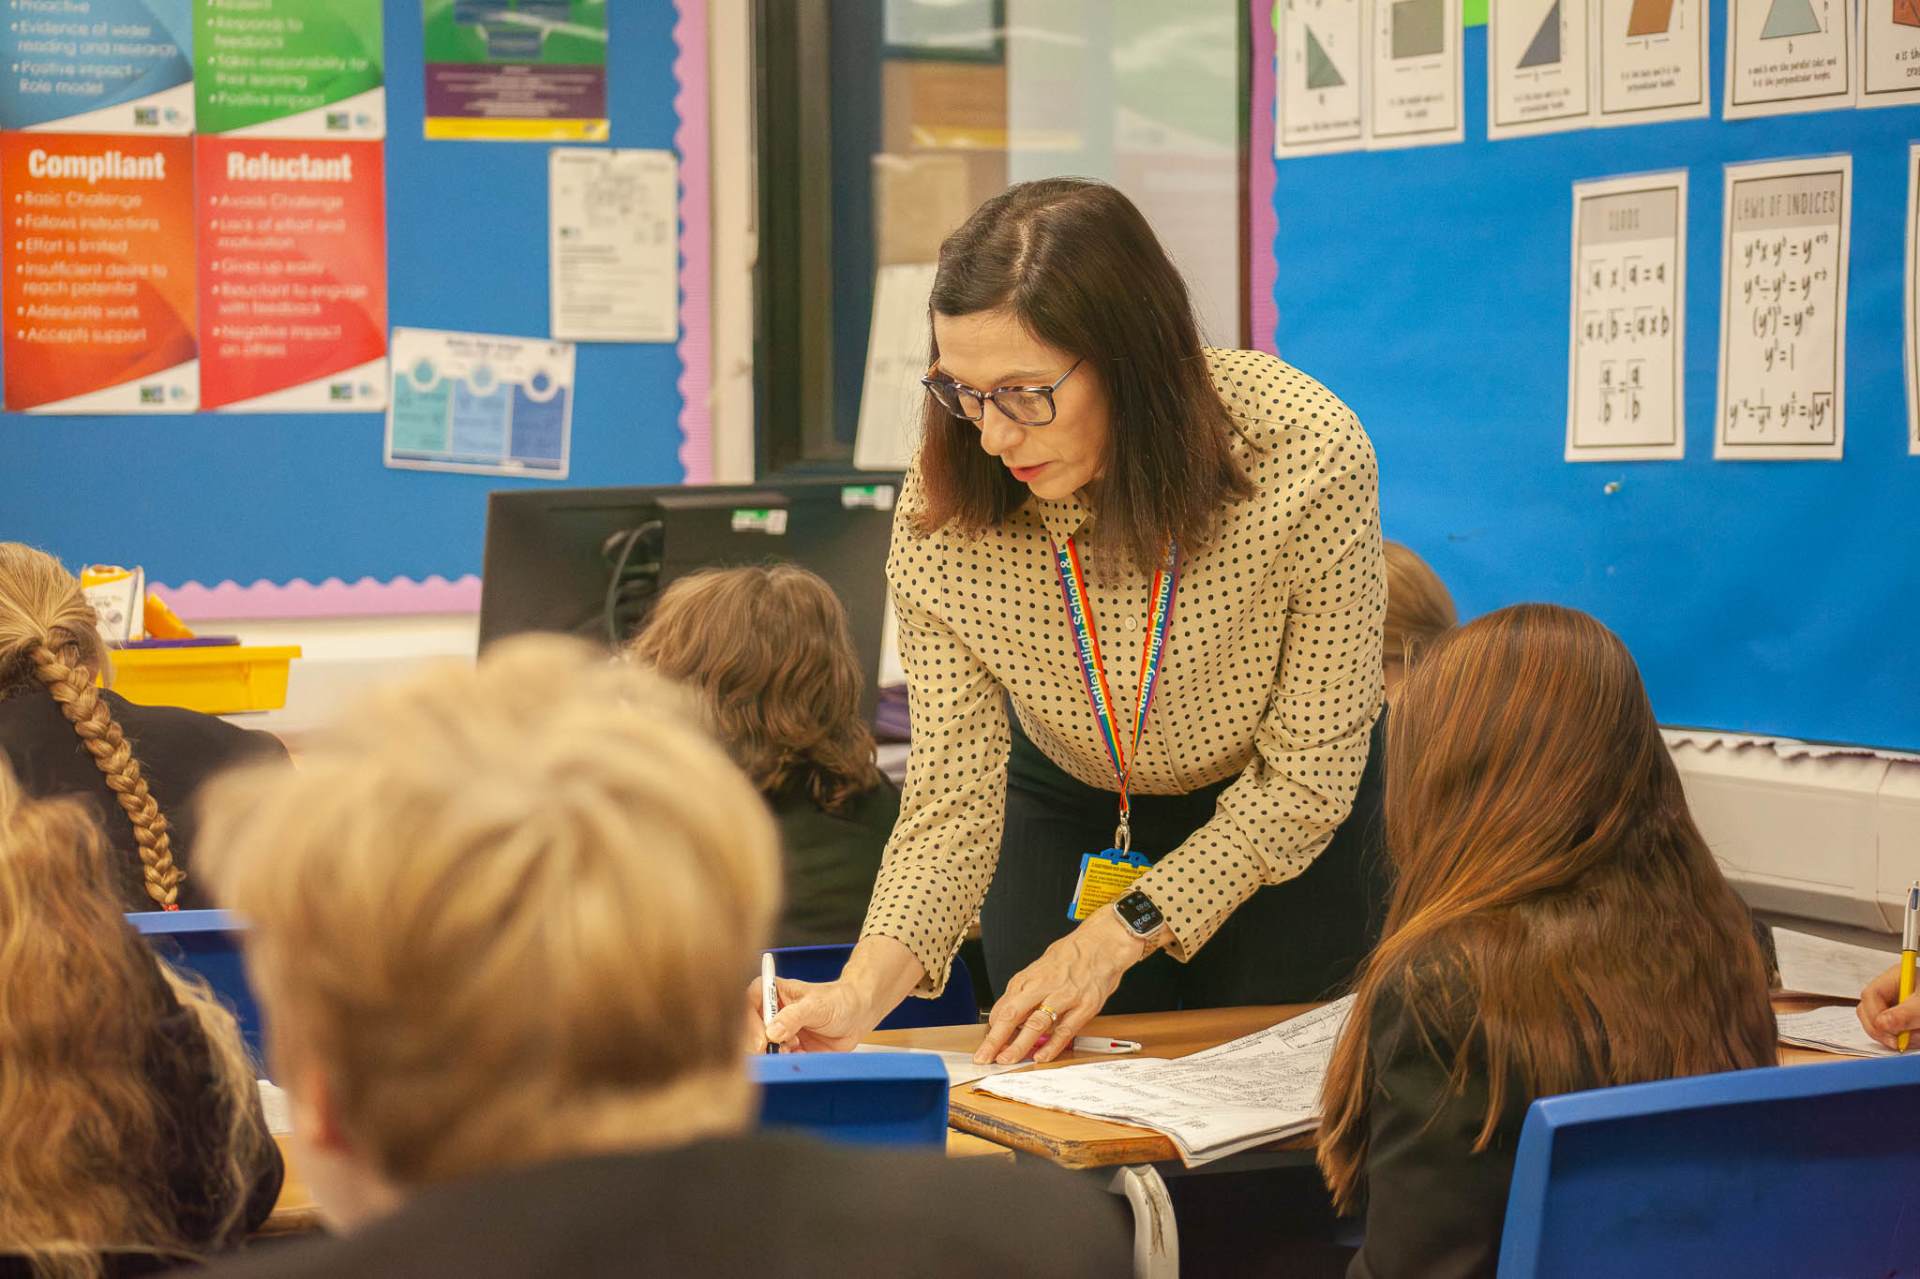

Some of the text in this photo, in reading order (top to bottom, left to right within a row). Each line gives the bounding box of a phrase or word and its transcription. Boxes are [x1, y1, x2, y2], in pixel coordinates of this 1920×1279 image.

[20, 20, 89, 36] Evidence
[92, 22, 108, 36] of
[80, 42, 110, 54] and
[21, 61, 133, 78] Positive impact
[20, 79, 104, 95] Role model
[28, 148, 166, 184] Compliant
[227, 151, 352, 182] Reluctant
[24, 191, 142, 209] Basic Challenge
[271, 194, 344, 213] Challenge
[1769, 194, 1782, 217] OF
[1786, 190, 1836, 216] INDICES
[24, 214, 77, 230] Follows
[220, 219, 252, 233] Lack
[256, 218, 273, 232] of
[25, 238, 129, 254] Effort is limited
[25, 261, 103, 277] Insufficient
[151, 264, 168, 278] to
[23, 281, 138, 298] reach potential
[221, 282, 290, 297] Reluctant
[26, 304, 140, 320] Adequate work
[27, 327, 147, 344] Accepts support
[222, 325, 342, 341] Negative impact
[1060, 558, 1073, 568] &
[1062, 573, 1088, 626] School
[1077, 630, 1095, 665] High
[1145, 627, 1163, 662] High
[1088, 667, 1107, 716] Notley
[1137, 665, 1156, 714] Notley
